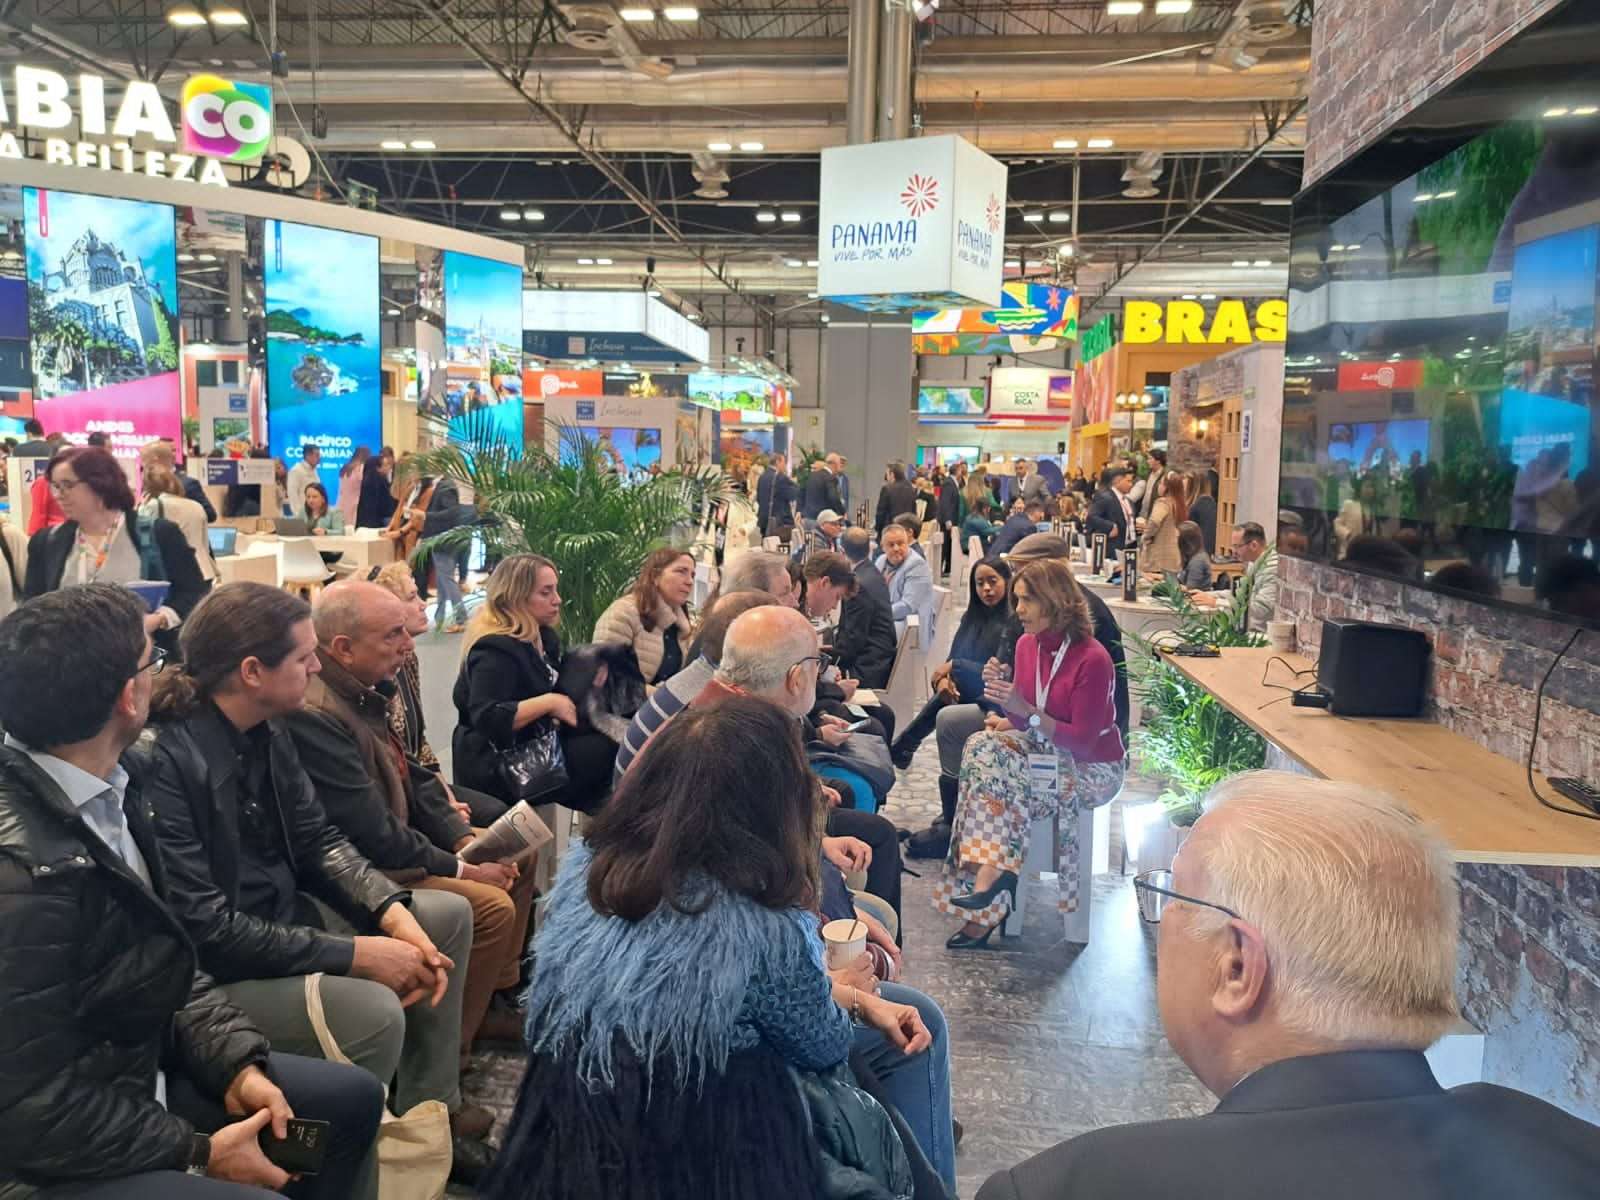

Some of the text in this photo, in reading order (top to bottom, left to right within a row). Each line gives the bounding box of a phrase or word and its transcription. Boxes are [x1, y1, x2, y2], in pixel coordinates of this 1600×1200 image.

[0, 64, 176, 142] BIA
[186, 93, 269, 144] CO
[832, 219, 917, 249] PANAMA
[834, 250, 859, 262] VIVE
[862, 249, 884, 261] POR
[1123, 300, 1288, 344] BRAS
[1014, 391, 1039, 399] COSTA
[25, 470, 33, 482] 2
